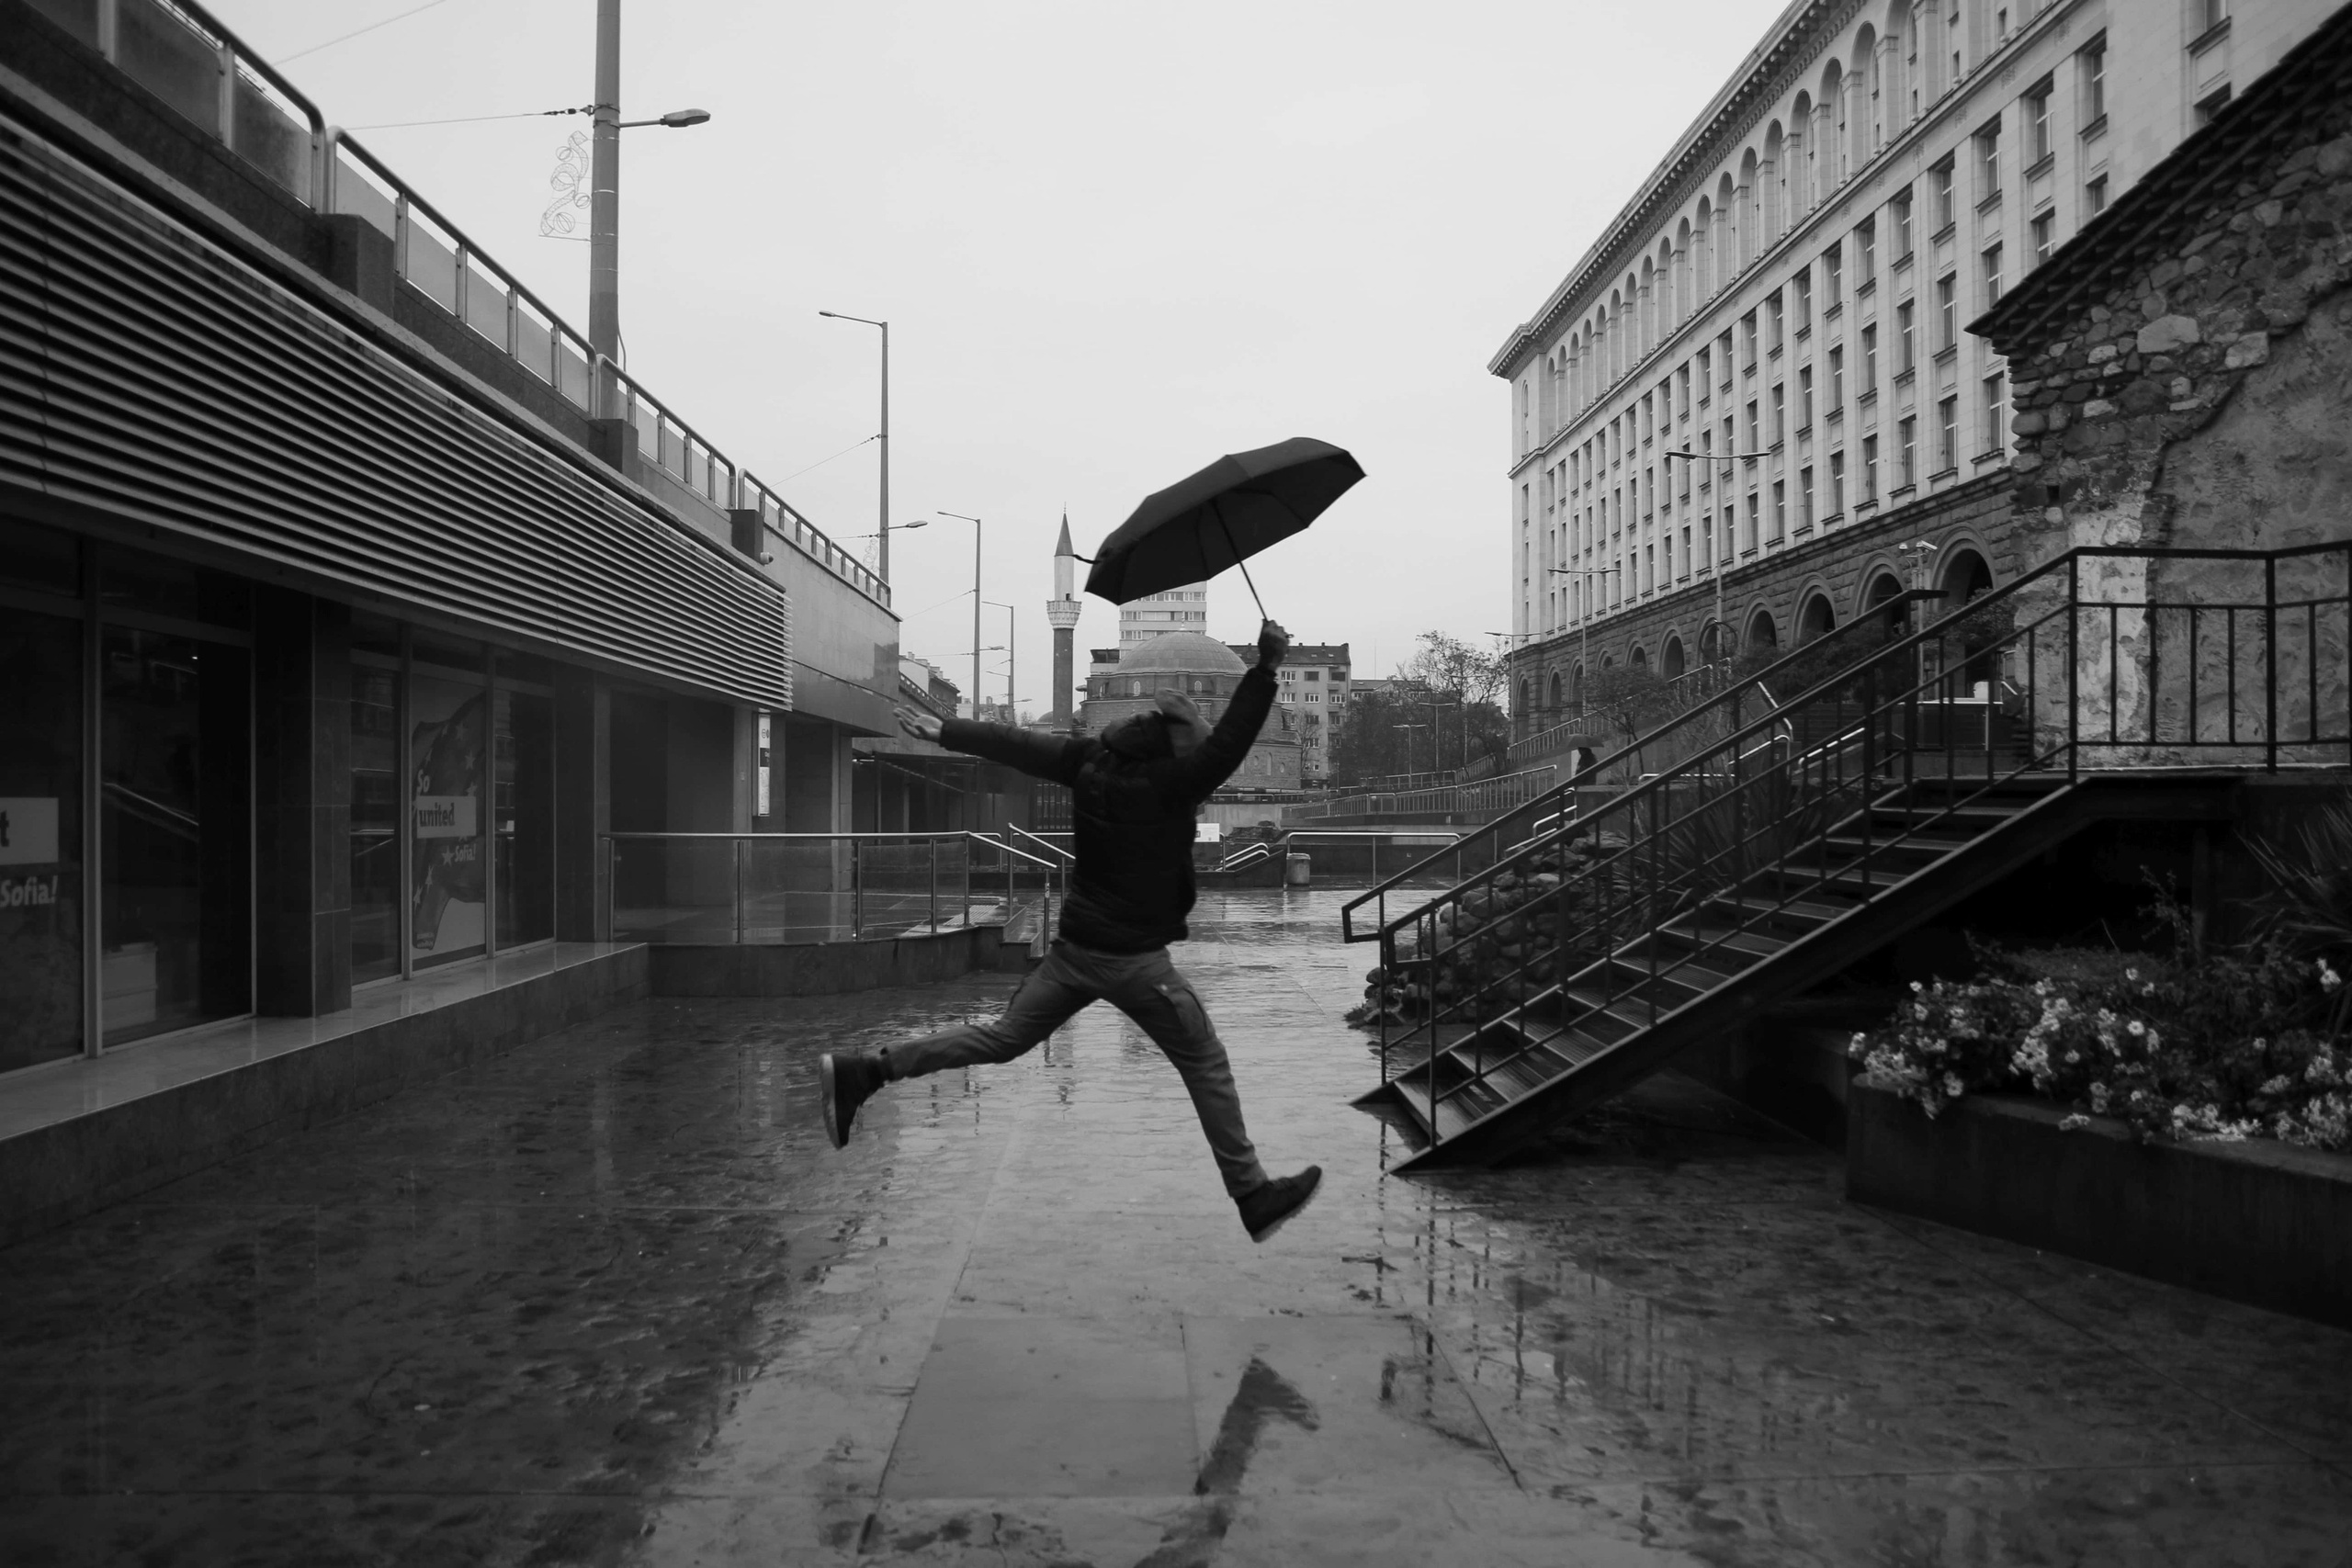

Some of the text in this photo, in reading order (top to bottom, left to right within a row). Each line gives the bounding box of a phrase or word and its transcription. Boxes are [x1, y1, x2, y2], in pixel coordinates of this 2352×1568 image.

[417, 769, 430, 794] So
[419, 802, 455, 827] united
[454, 843, 477, 863] Sofia!
[0, 874, 59, 908] Sofia!
